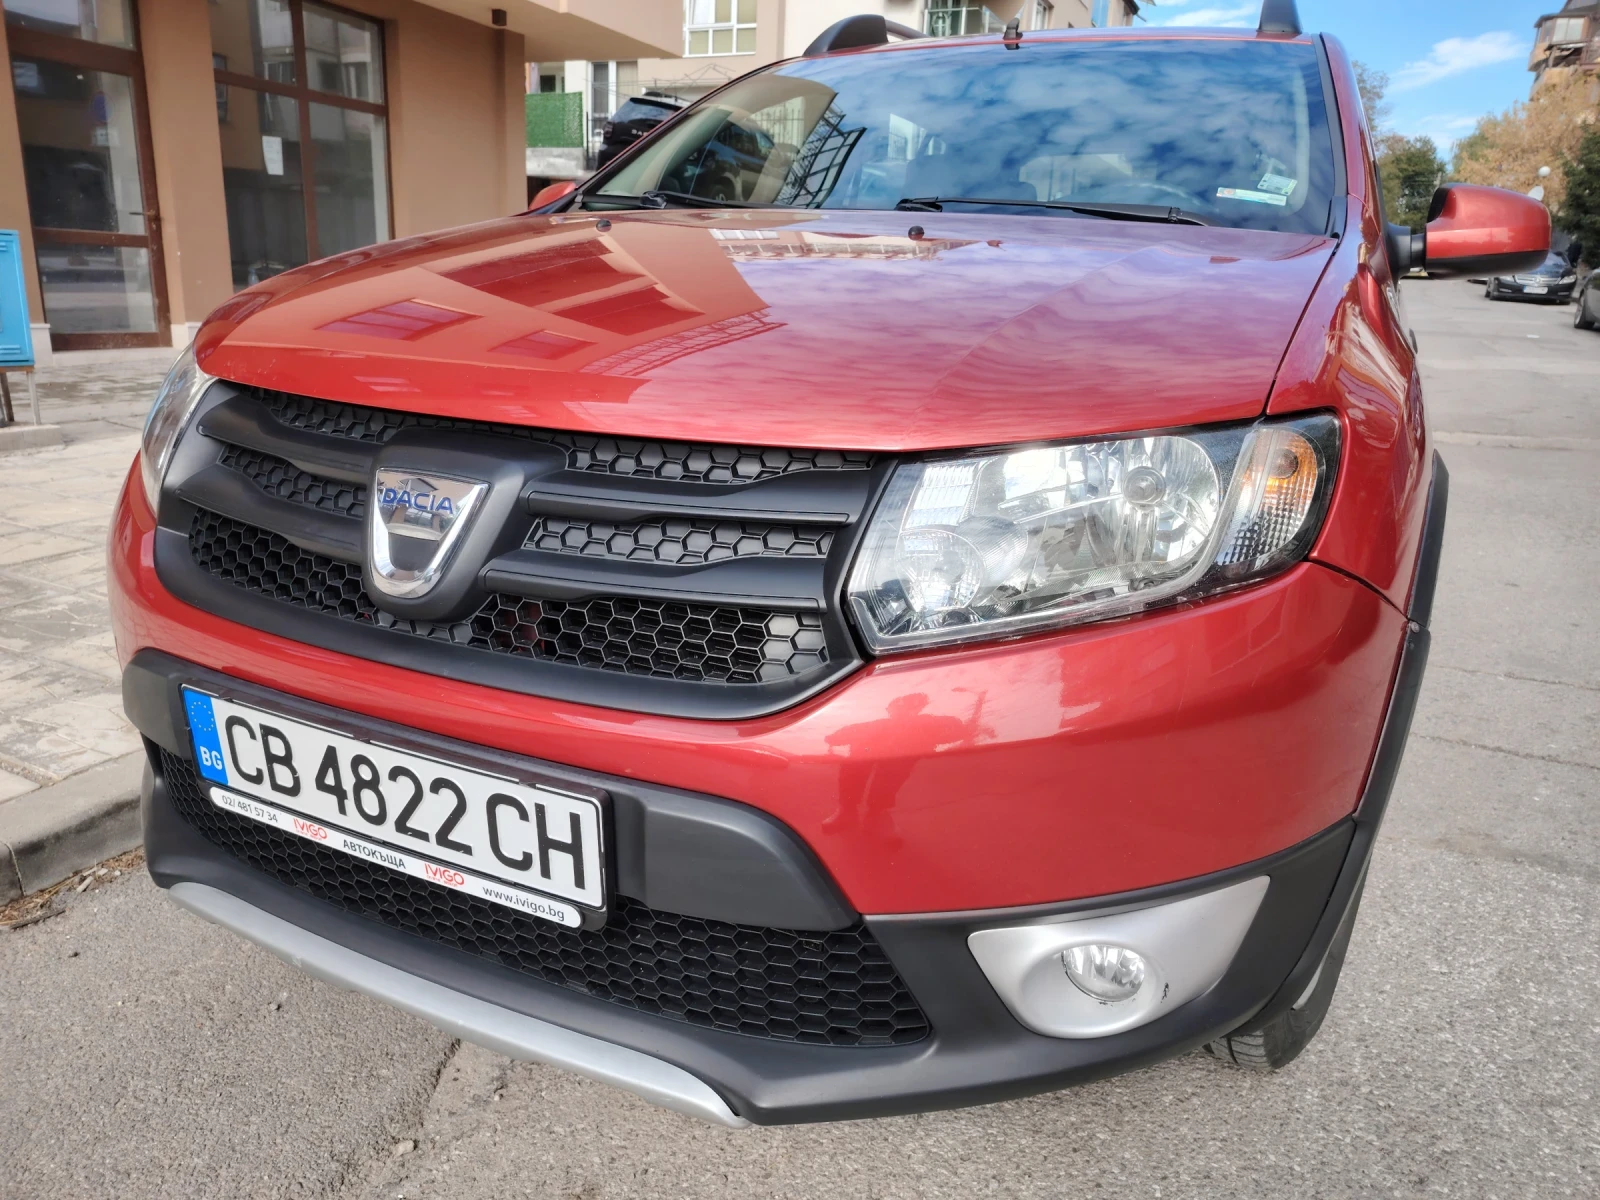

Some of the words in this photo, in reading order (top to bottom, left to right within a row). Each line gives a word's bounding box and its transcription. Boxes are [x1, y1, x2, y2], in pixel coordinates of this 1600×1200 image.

[381, 487, 455, 515] DACIA
[200, 746, 223, 770] BG
[225, 715, 301, 797] CB
[315, 745, 473, 856] 4822
[486, 793, 586, 890] CH
[237, 800, 253, 814] 481
[254, 807, 265, 818] 57
[266, 811, 278, 823] 34
[293, 818, 328, 839] IVIGO
[343, 839, 407, 869] АВТОКЪЩА
[424, 862, 465, 886] IVIGO
[482, 886, 565, 922] www.ivigo.bg
